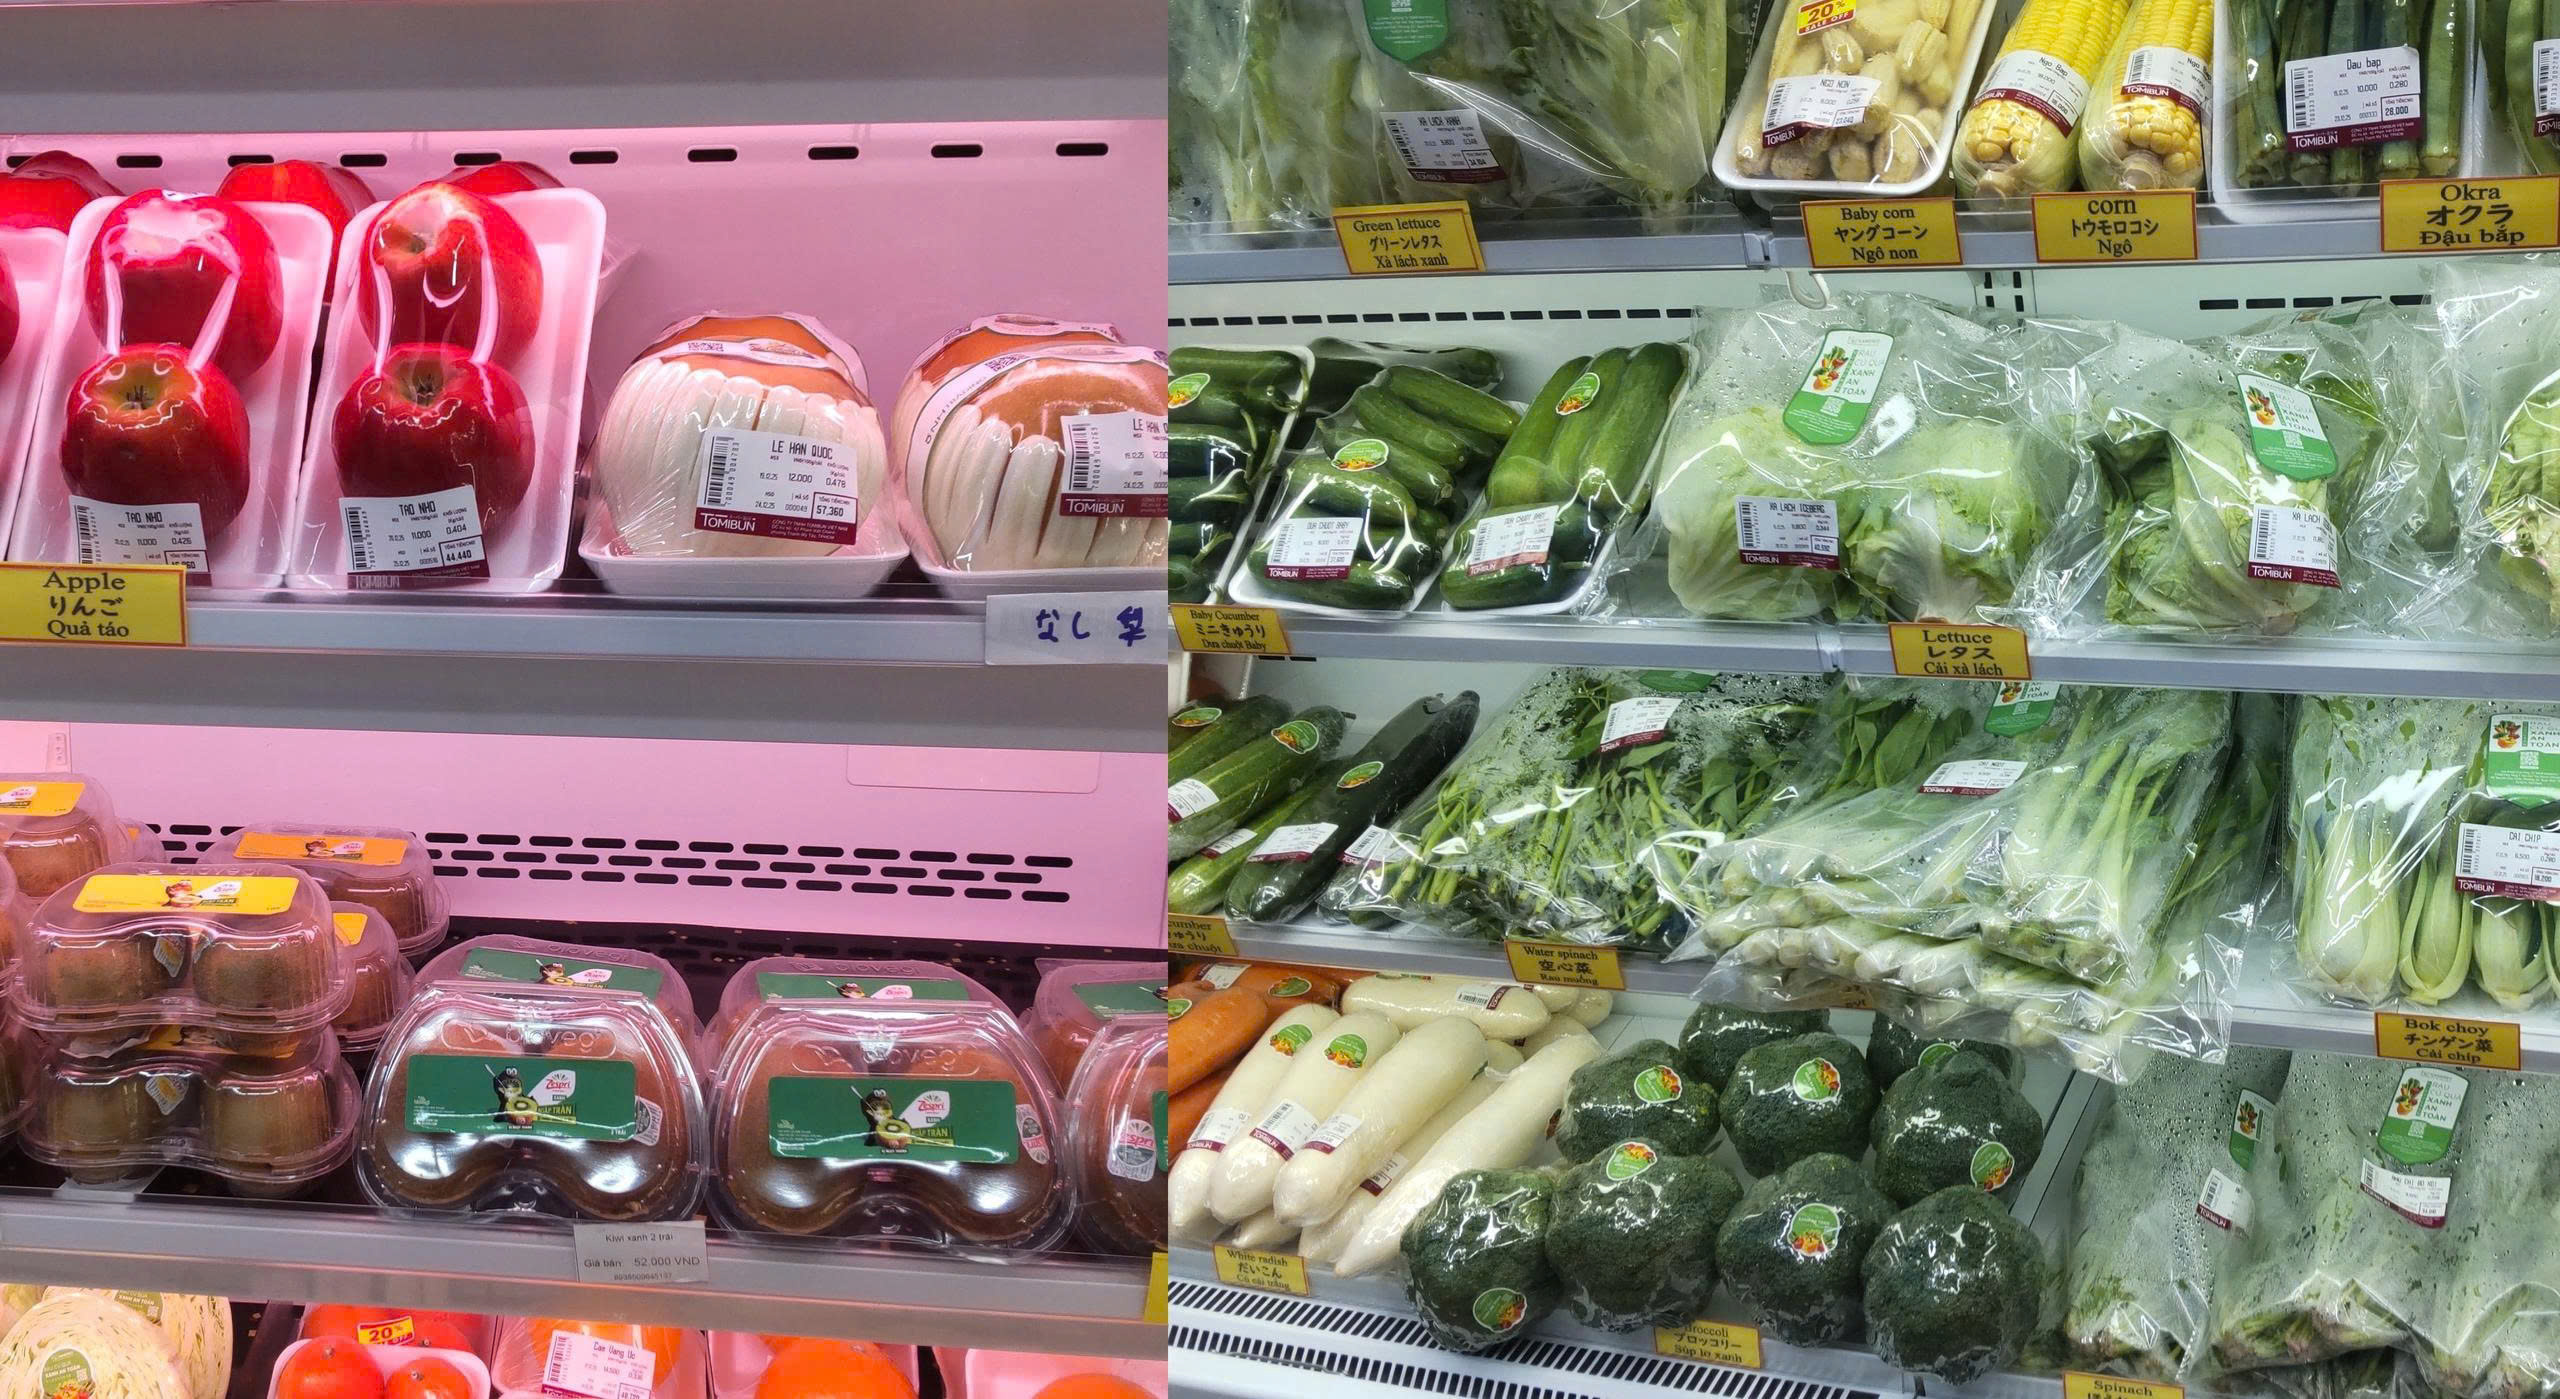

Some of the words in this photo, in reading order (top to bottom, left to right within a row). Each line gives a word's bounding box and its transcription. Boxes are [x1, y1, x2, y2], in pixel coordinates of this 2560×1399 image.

[1805, 20, 1826, 31] SALE
[1831, 12, 1849, 21] OFF
[2346, 58, 2361, 70] Dau
[2366, 57, 2381, 69] bap
[2126, 85, 2170, 97] TOMIBUN
[2389, 80, 2408, 89] 0.280
[2292, 131, 2338, 148] TOMIBUN
[2440, 184, 2502, 201] Okra
[1841, 207, 1878, 222] Baby
[1883, 208, 1915, 219] corn
[2088, 198, 2137, 215] corn
[2426, 203, 2514, 226] オクラ
[1353, 219, 1394, 233] Green
[1396, 217, 1441, 229] lettuce
[1834, 223, 1928, 243] ヤングコーン
[2072, 218, 2159, 238] トウモロコシ
[1369, 235, 1443, 252] グリーンレタス
[2419, 230, 2471, 247] Đậu
[2480, 224, 2525, 246] bắp
[1851, 246, 1885, 263] Ngô
[1889, 248, 1919, 259] non
[2097, 239, 2133, 258] Ngô
[1375, 254, 1393, 269] Xà
[1395, 253, 1418, 267] lách
[1421, 253, 1449, 267] xanh
[1133, 418, 1143, 431] LE
[772, 440, 783, 454] LE
[789, 442, 807, 456] HAN
[812, 444, 833, 460] QUOC
[788, 473, 813, 483] 12.000
[825, 477, 846, 488] 0.478
[399, 504, 415, 516] TAO
[418, 500, 436, 513] NHO
[1065, 499, 1125, 513] TOMIBUN
[700, 513, 755, 532] TOMIBUN
[2292, 511, 2301, 520] XA
[446, 524, 467, 535] 0.404
[2251, 565, 2292, 579] TOMIBUN
[43, 571, 126, 593] Apple
[50, 596, 123, 616] りんご
[1190, 609, 1213, 621] Baby
[1215, 610, 1260, 621] Cucumber
[47, 619, 91, 638] Quả
[97, 622, 129, 637] táo
[1195, 622, 1265, 638] ミニきゅうり
[1922, 629, 1993, 644] Lettuce
[1246, 640, 1266, 651] Baby
[1928, 646, 1994, 660] レタス
[1924, 661, 1948, 674] Cải
[1953, 664, 1970, 676] xà
[1974, 662, 2003, 676] lách
[2509, 831, 2520, 840] CAI
[2524, 833, 2541, 843] CHIP
[2457, 879, 2495, 892] TOMIBUN
[1523, 945, 1554, 957] Water
[1558, 948, 1599, 961] spinach
[1538, 959, 1593, 975] 空心菜
[2404, 1018, 2441, 1031] Bok
[2446, 1021, 2489, 1037] choy
[2404, 1033, 2494, 1052] チンゲン菜
[2416, 1047, 2442, 1059] Cải
[2447, 1051, 2481, 1063] chip
[545, 1078, 570, 1090] Zespri
[918, 1099, 944, 1112] Zespri
[2427, 1096, 2452, 1107] XANH
[605, 1234, 624, 1242] Kiwi
[584, 1259, 602, 1268] Giá
[1227, 1249, 1255, 1261] White
[1258, 1255, 1288, 1267] radish
[1238, 1262, 1282, 1279] だいこん
[1715, 1351, 1742, 1362] xanh
[2094, 1380, 2153, 1397] Spinach
